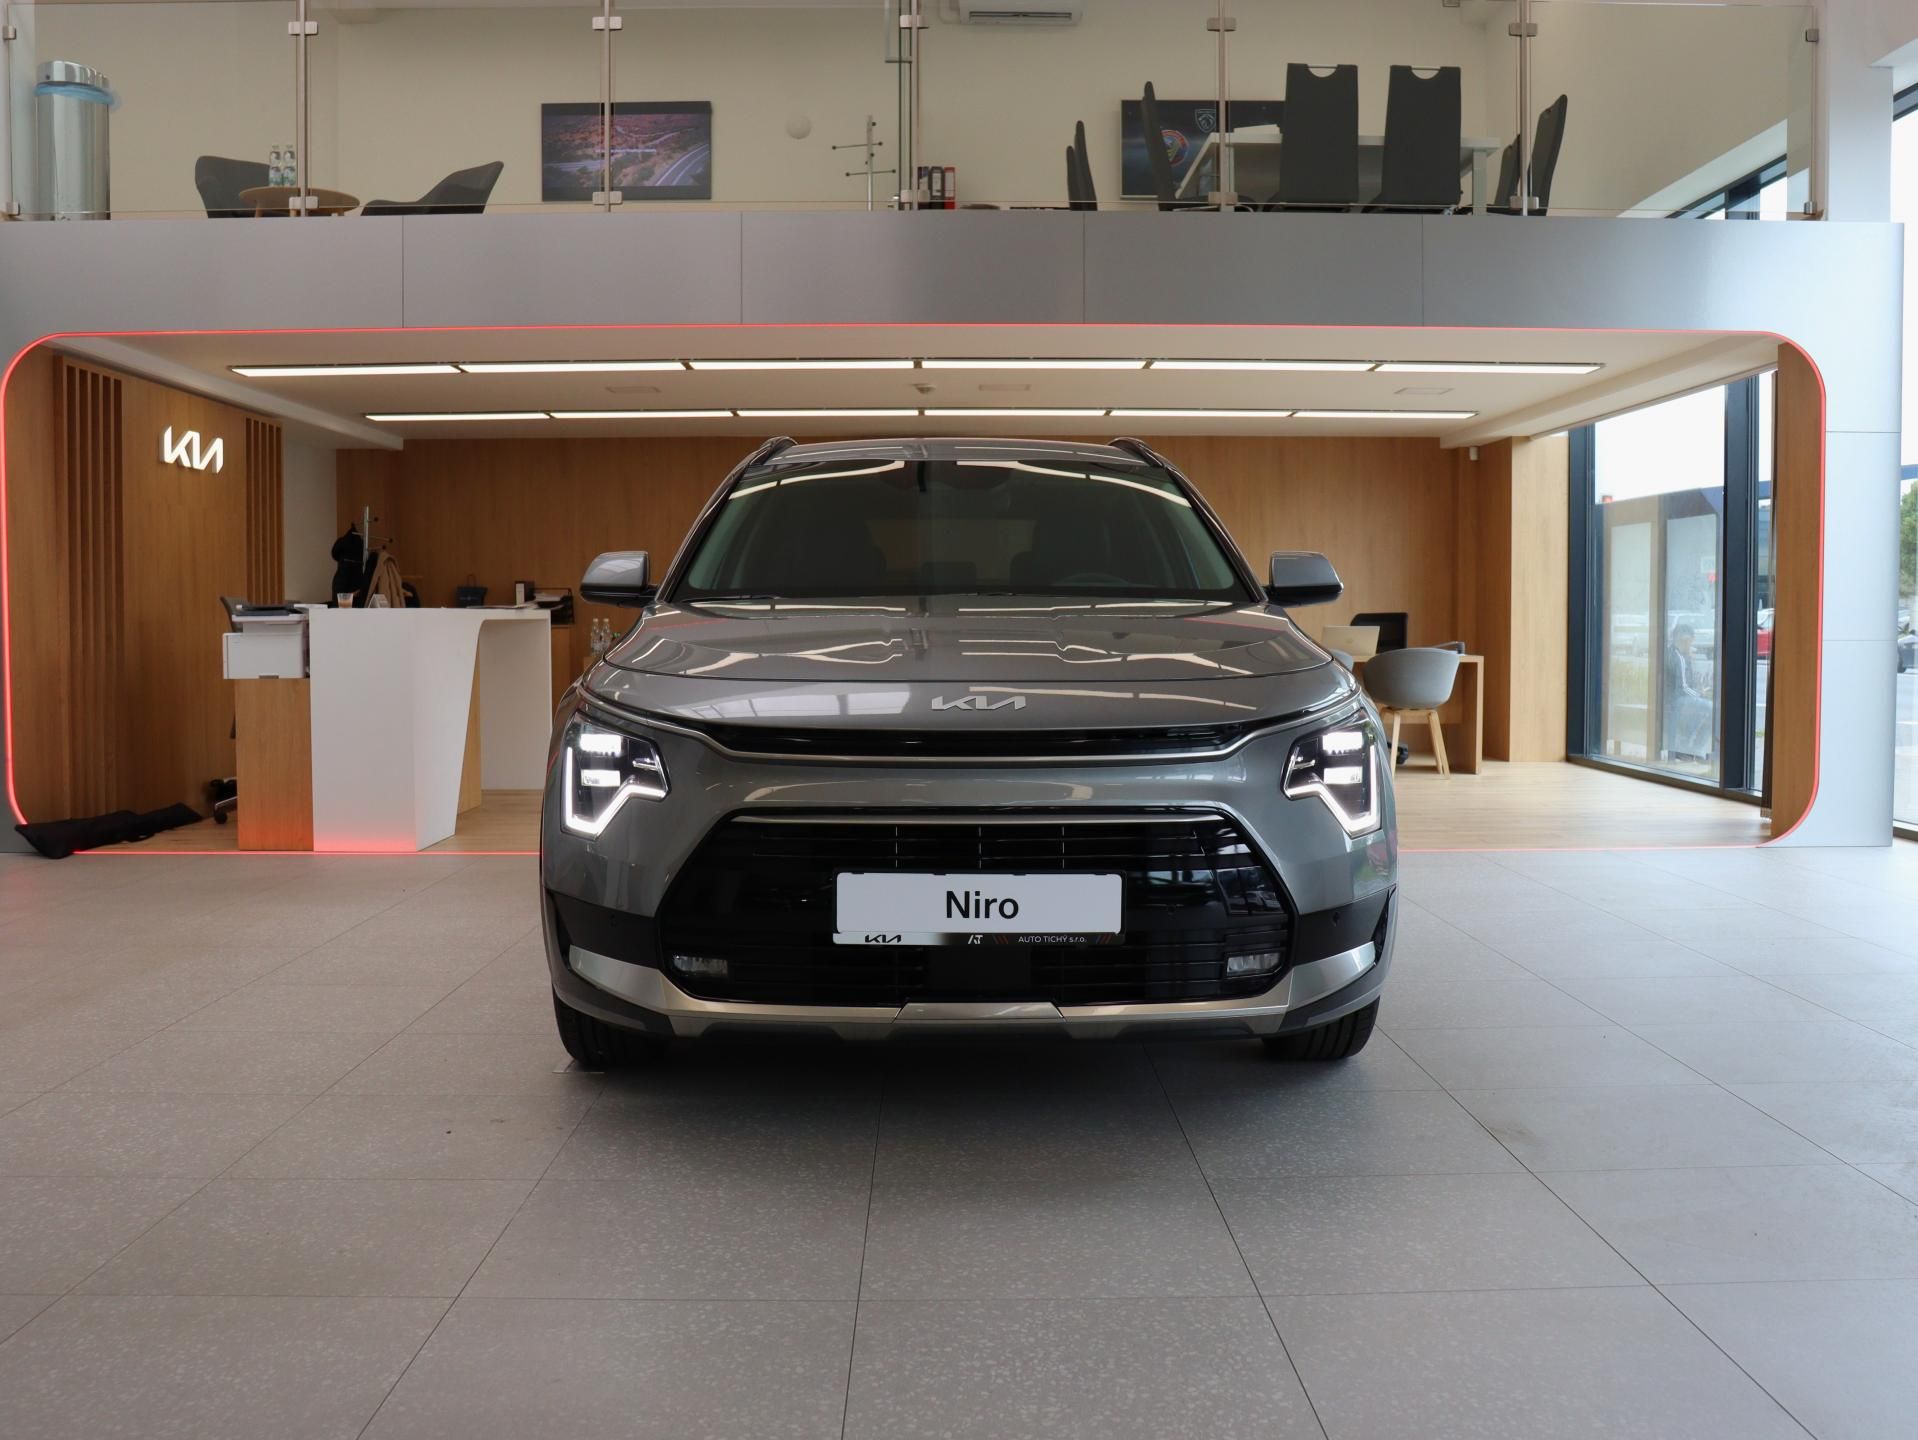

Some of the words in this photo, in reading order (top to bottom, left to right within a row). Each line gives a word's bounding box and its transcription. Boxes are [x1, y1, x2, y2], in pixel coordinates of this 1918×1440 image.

[160, 426, 224, 474] KIA
[931, 696, 1026, 710] KIA
[946, 891, 1019, 919] Niro
[864, 934, 902, 944] KIA
[1018, 935, 1041, 943] AUTO
[1043, 934, 1068, 943] TICHÝ
